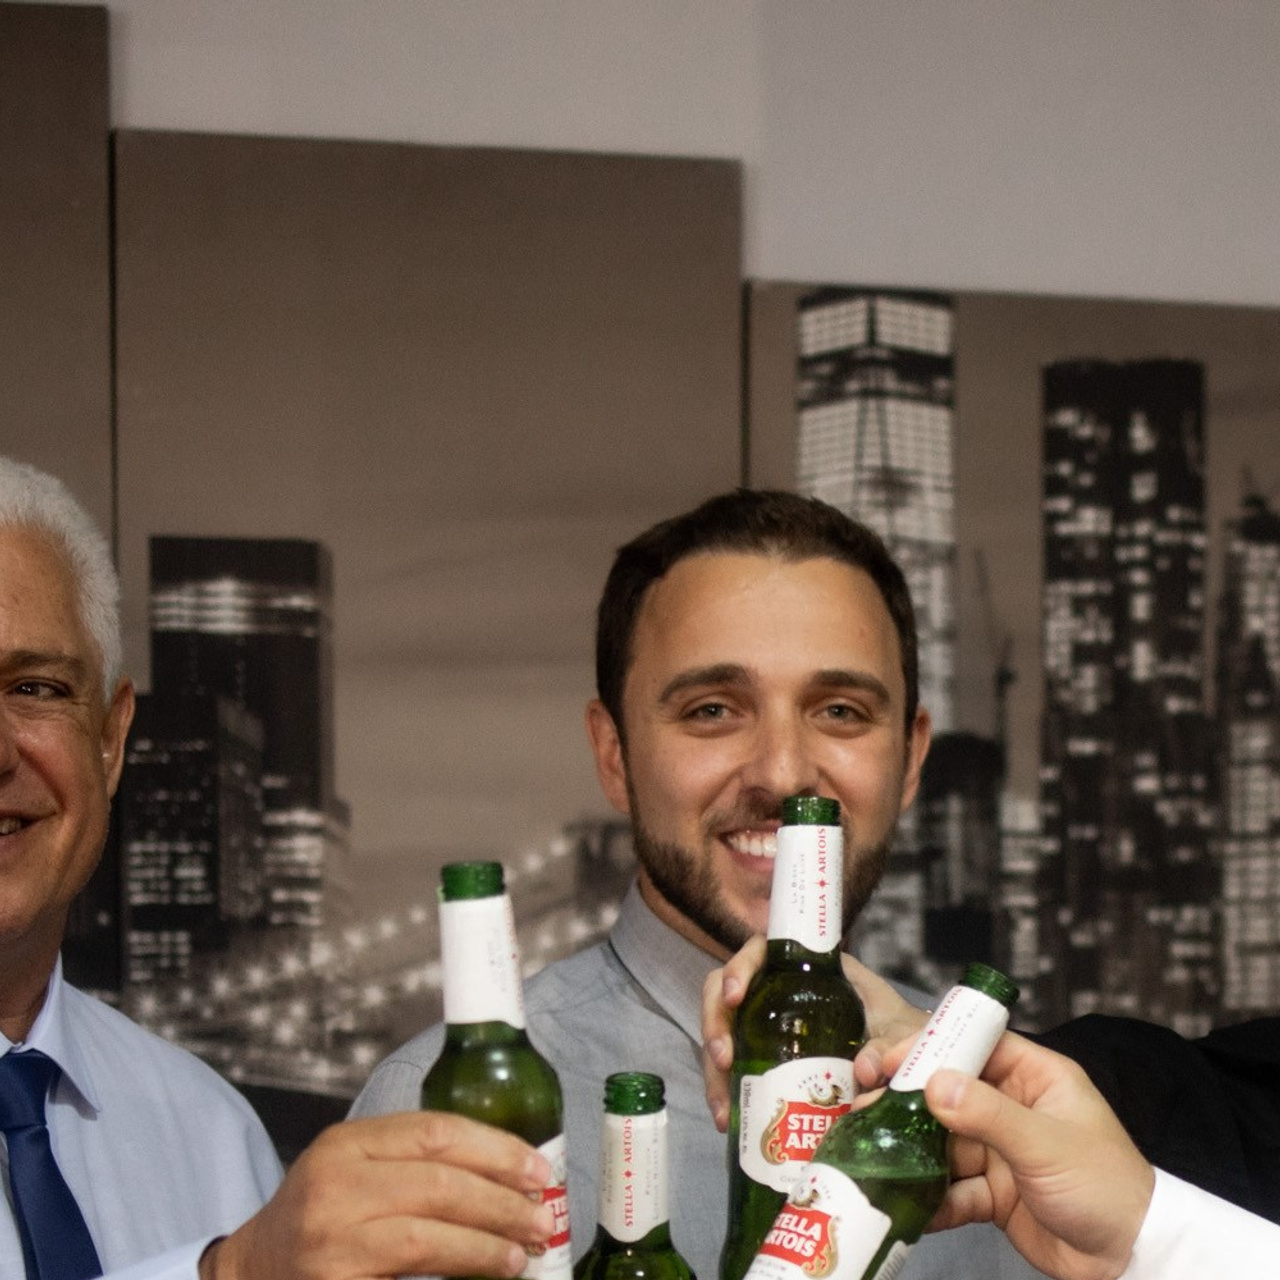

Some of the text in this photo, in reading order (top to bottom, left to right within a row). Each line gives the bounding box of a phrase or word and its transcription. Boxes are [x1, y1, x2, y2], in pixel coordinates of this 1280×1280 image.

[817, 828, 827, 937] STELLA ARTOIS
[902, 1041, 928, 1077] STELLA
[935, 987, 962, 1025] ARTOIS
[787, 1113, 838, 1131] STEL
[623, 1117, 633, 1227] STELLA ARTOIS
